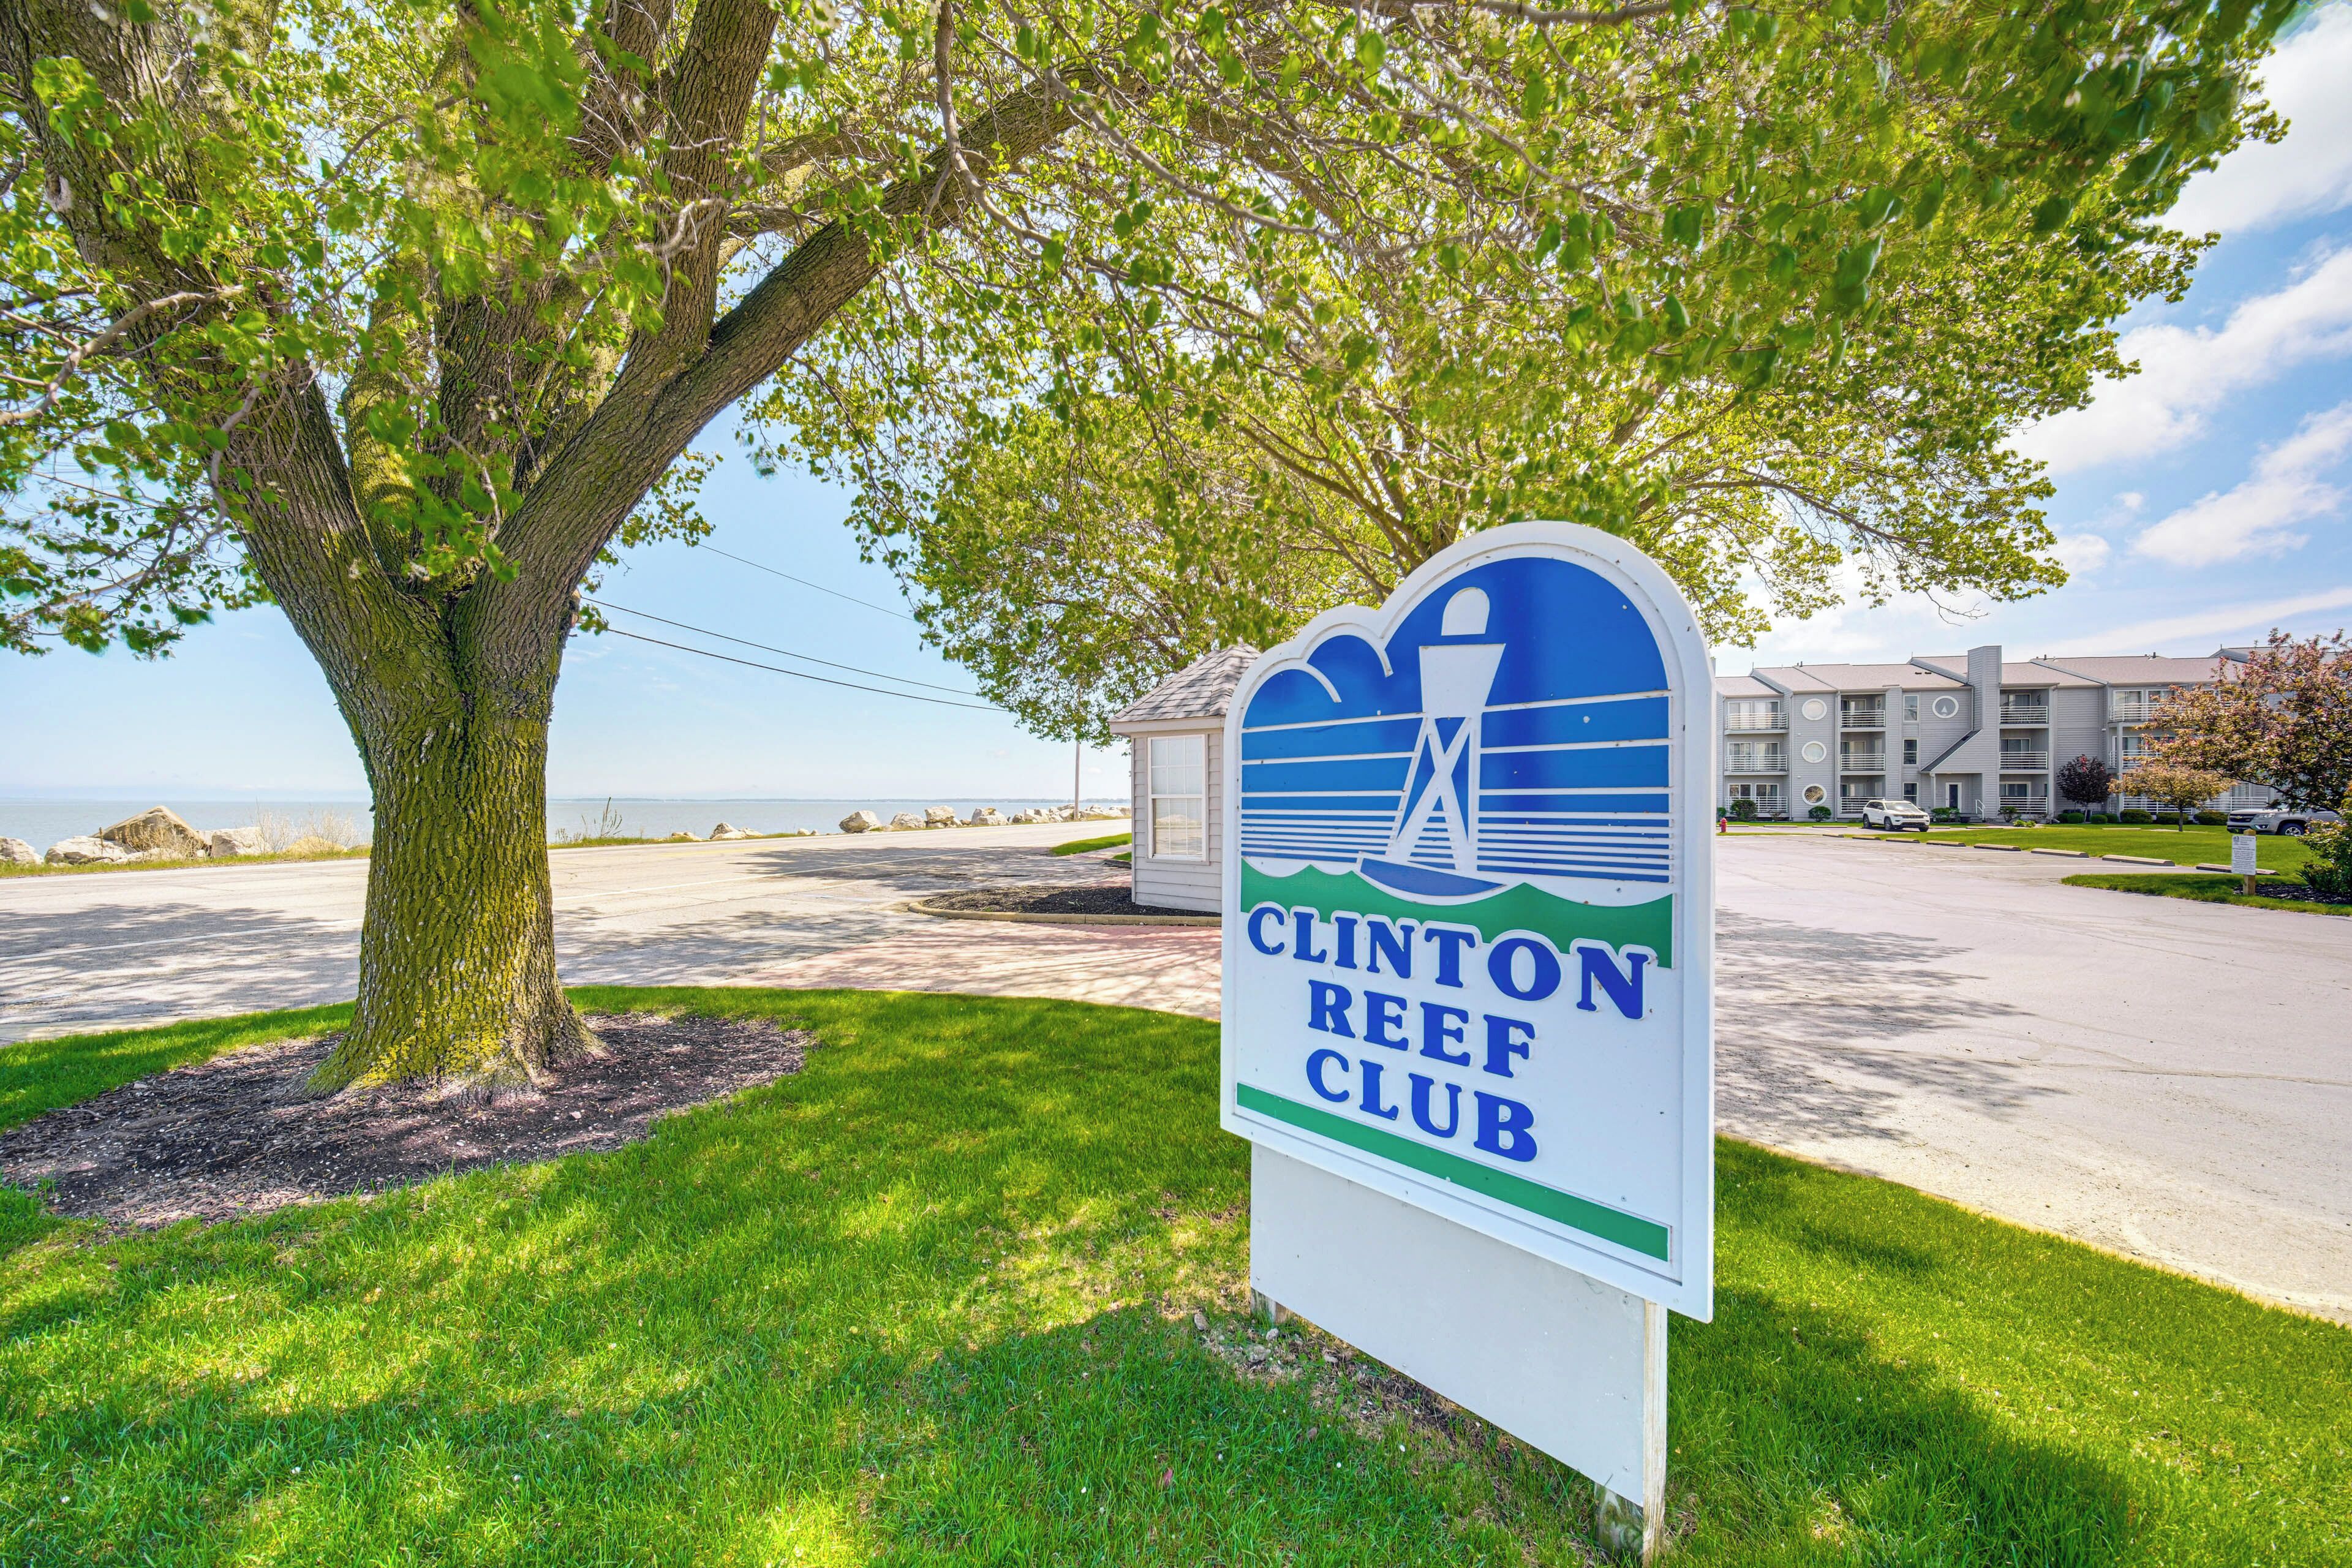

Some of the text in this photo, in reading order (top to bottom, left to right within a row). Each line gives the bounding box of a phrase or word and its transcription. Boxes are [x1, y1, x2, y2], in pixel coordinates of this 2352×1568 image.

[1248, 907, 1649, 1020] CLINTON
[1308, 979, 1536, 1079] REEF
[1306, 1049, 1538, 1163] CLUB
